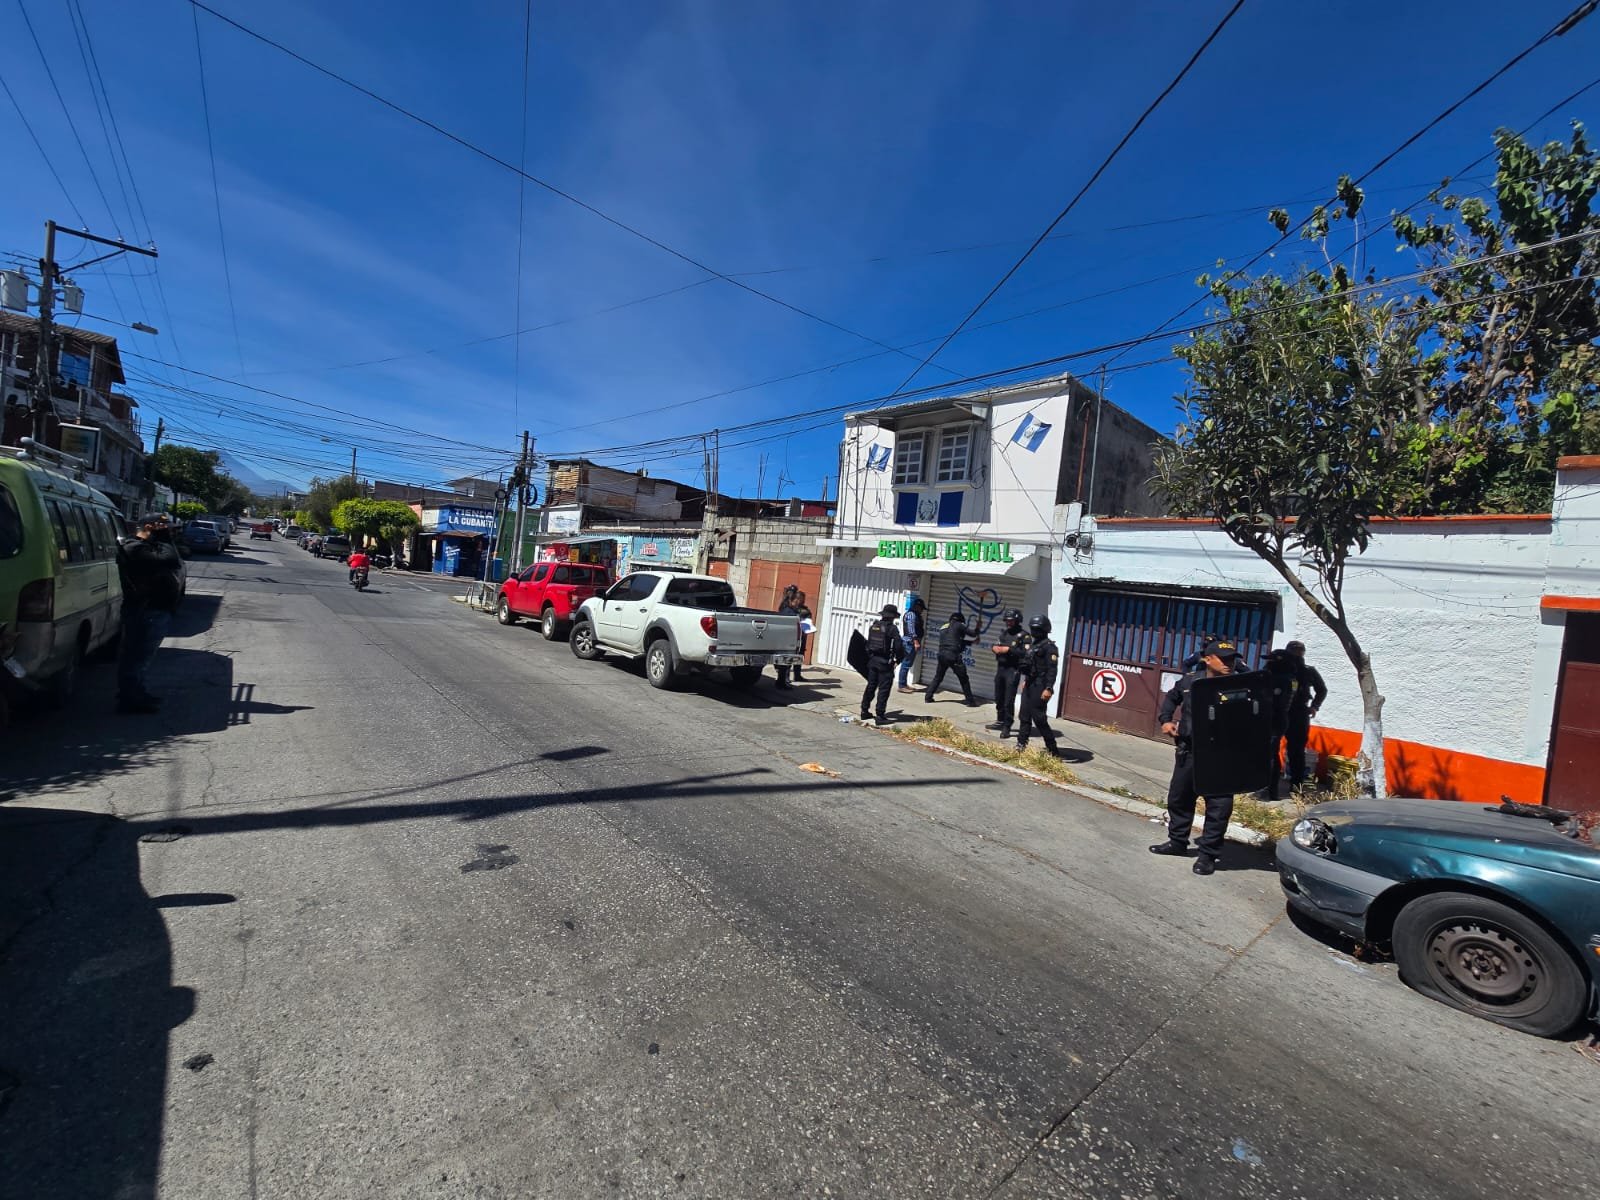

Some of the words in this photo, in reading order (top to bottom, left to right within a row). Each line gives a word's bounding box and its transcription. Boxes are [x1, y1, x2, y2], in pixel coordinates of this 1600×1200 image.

[449, 515, 459, 525] LA
[454, 508, 494, 519] TIENDA
[878, 540, 937, 560] CENTRO
[945, 541, 1013, 563] DENTAL
[1094, 660, 1142, 674] ESTACIONAR
[1101, 676, 1116, 695] E
